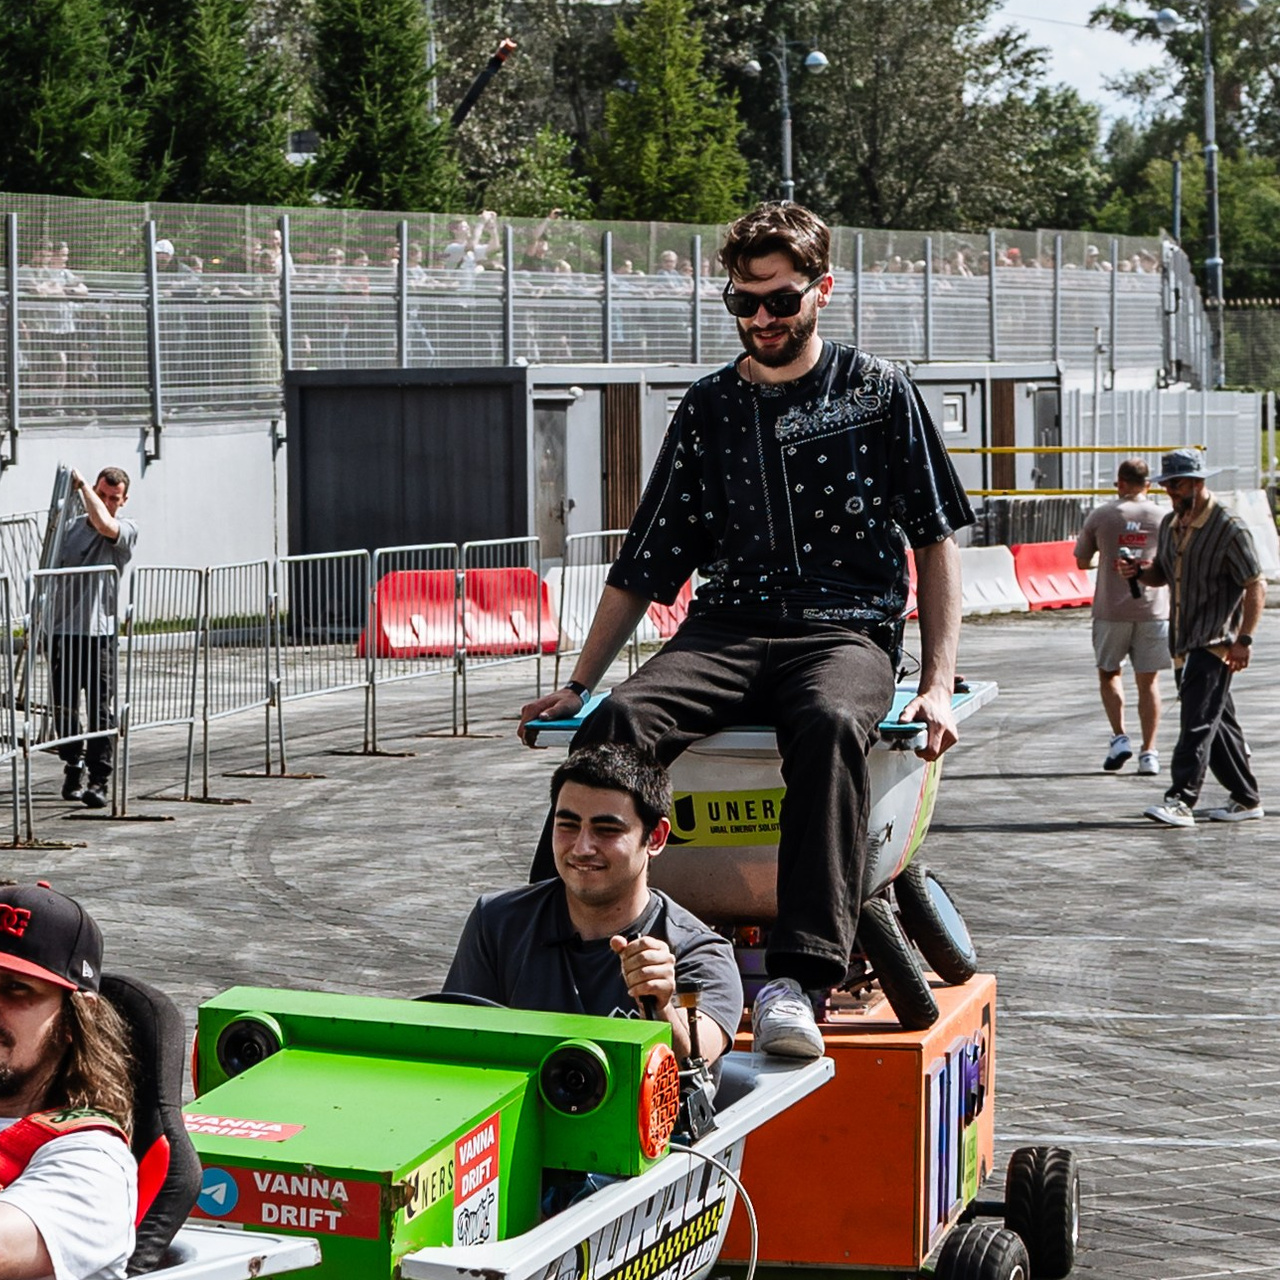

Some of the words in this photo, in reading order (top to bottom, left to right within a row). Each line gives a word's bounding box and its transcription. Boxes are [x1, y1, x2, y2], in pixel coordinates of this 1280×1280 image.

[1125, 521, 1142, 531] IN
[708, 800, 781, 821] UNER
[710, 825, 728, 834] URAL
[730, 824, 757, 834] ENERGY
[758, 822, 781, 833] SOLUT
[184, 1123, 270, 1139] DRIFT
[185, 1114, 283, 1132] VANNA
[459, 1124, 495, 1166] VANNA
[253, 1172, 349, 1202] VANNA
[461, 1156, 493, 1197] DRIFT
[262, 1202, 342, 1231] DRIFT
